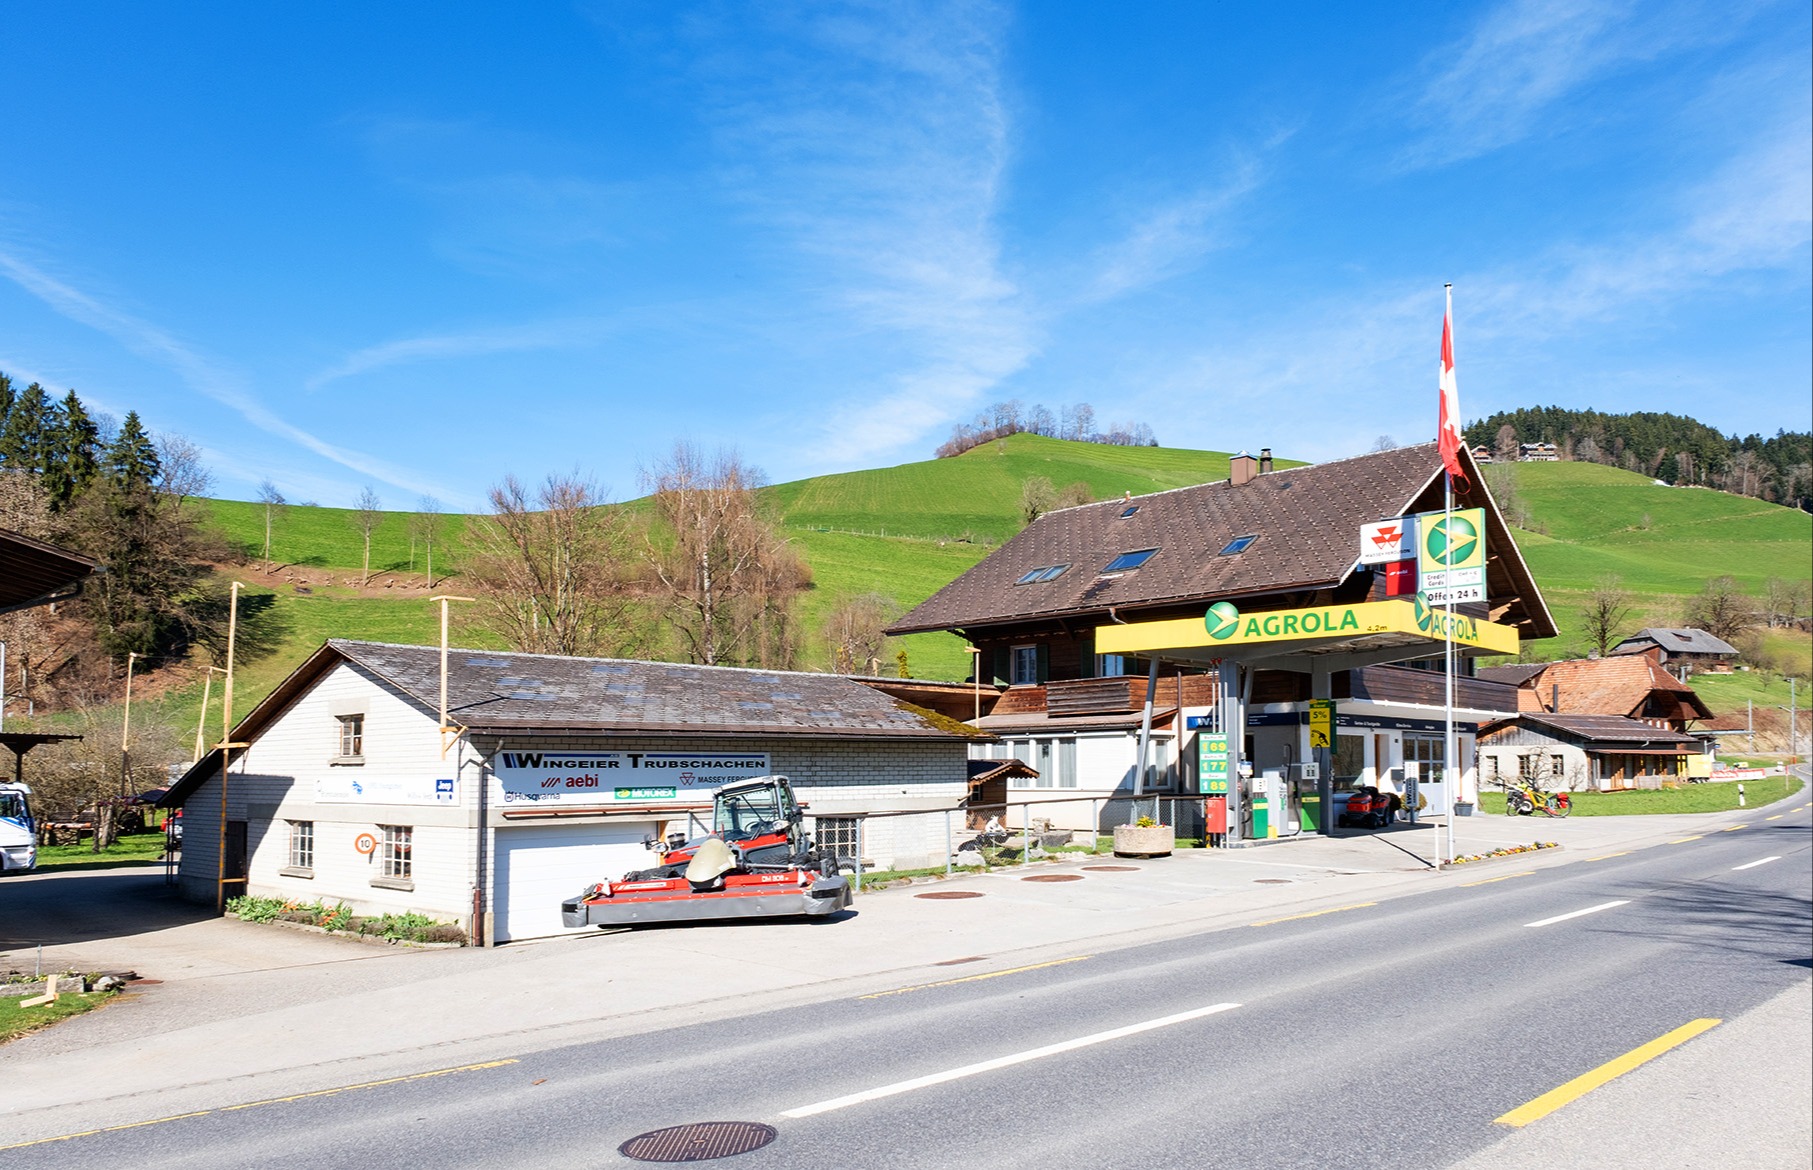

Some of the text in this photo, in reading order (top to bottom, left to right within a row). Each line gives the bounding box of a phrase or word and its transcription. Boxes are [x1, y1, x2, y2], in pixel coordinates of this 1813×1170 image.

[1457, 590, 1469, 599] 24
[1472, 588, 1478, 597] h
[1244, 609, 1359, 637] AGROLA
[1432, 614, 1479, 642] AGROLA
[1313, 711, 1327, 719] 5%
[1202, 742, 1227, 752] 169
[515, 753, 765, 769] WINGEIER TRUBSCHACHEN
[1202, 761, 1227, 771] 177
[565, 774, 599, 788] aebi
[1202, 781, 1227, 791] 189
[514, 791, 561, 802] Husqvarna
[631, 788, 675, 798] MOTOREX
[360, 839, 371, 848] 10
